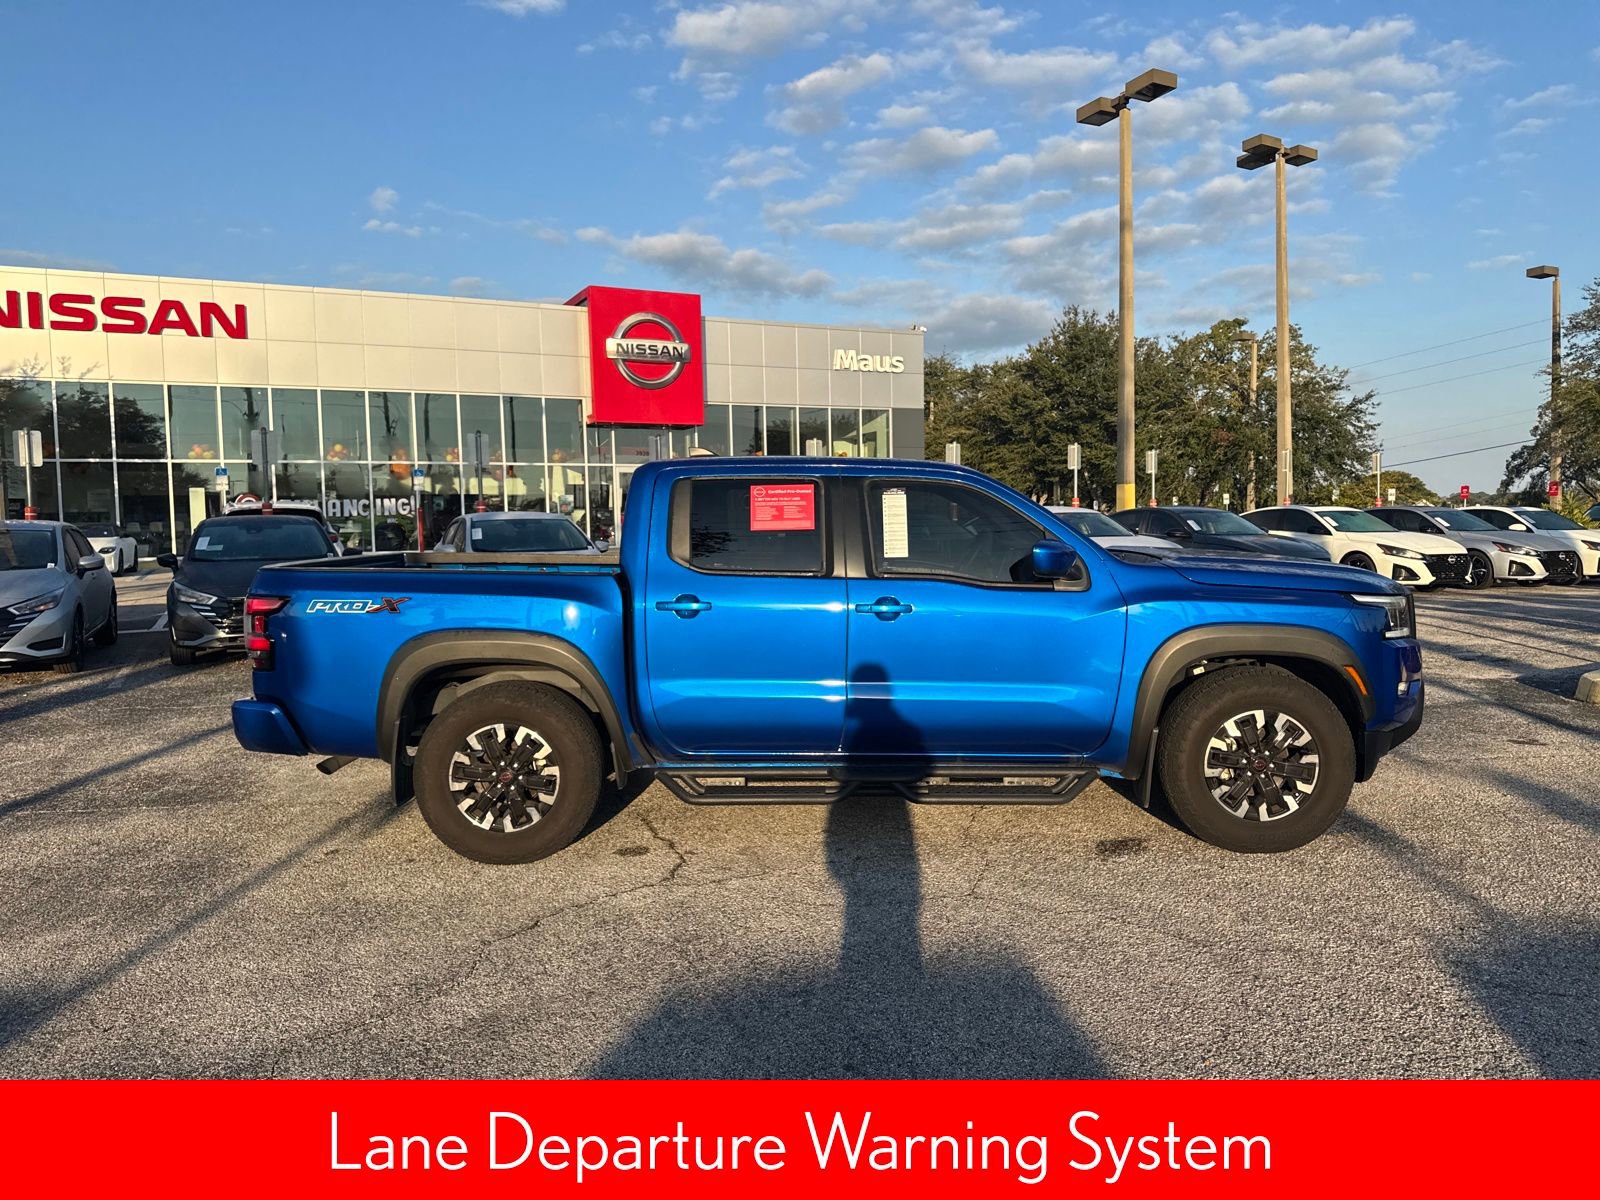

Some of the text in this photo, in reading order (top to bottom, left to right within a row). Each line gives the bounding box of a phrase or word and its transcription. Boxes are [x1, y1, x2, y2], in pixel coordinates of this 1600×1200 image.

[616, 343, 683, 359] NISSAN
[833, 349, 905, 373] Maus
[280, 496, 416, 517] ANCING!
